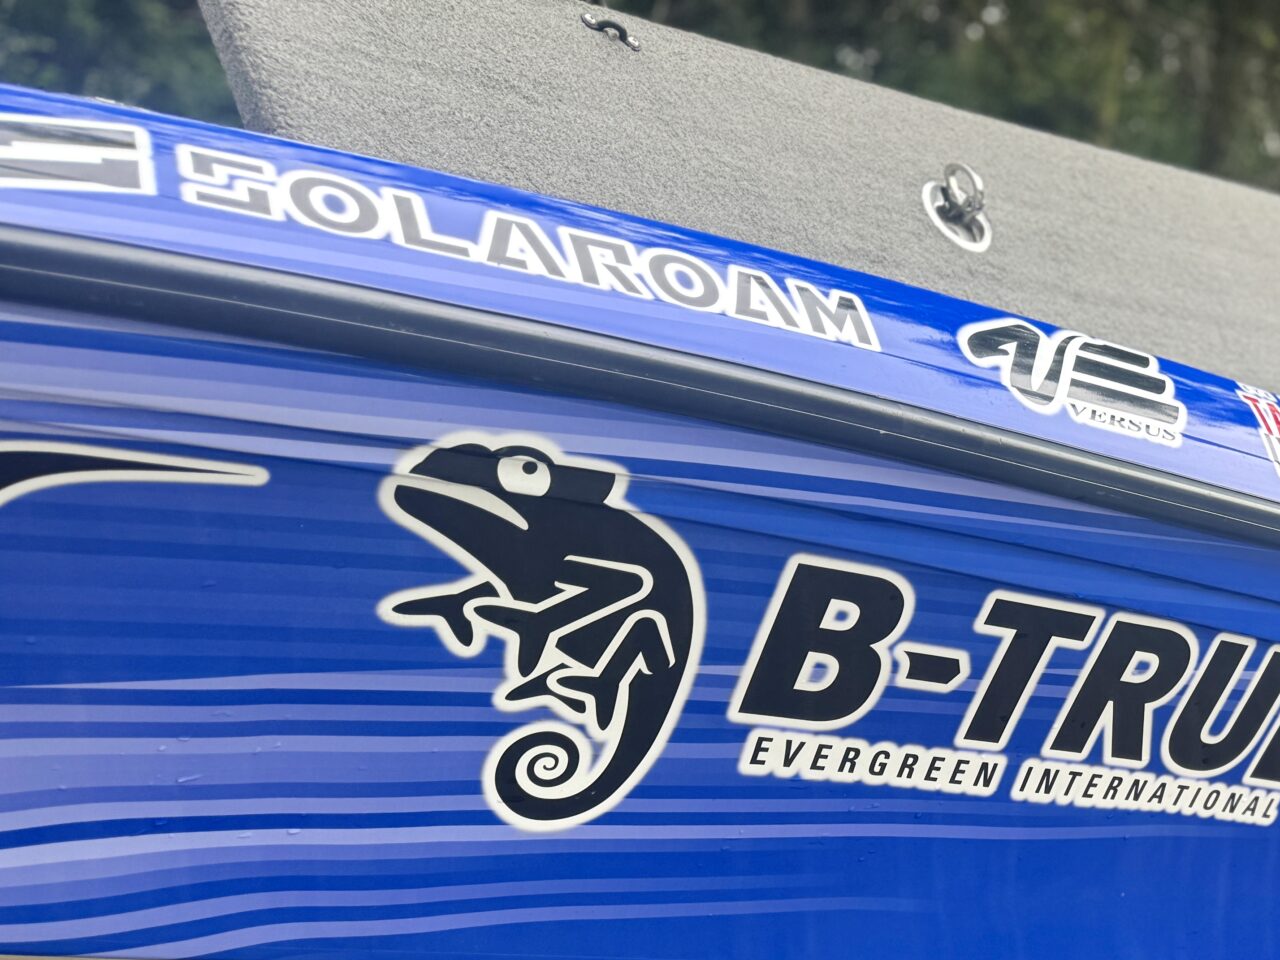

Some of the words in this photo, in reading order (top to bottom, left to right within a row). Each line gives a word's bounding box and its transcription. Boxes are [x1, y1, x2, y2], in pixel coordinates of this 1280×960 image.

[185, 148, 876, 348] SOLAROAM
[1069, 402, 1177, 441] VERSUS
[748, 736, 999, 789] EVERGREEN
[1018, 765, 1280, 820] INTERNATIONAL
